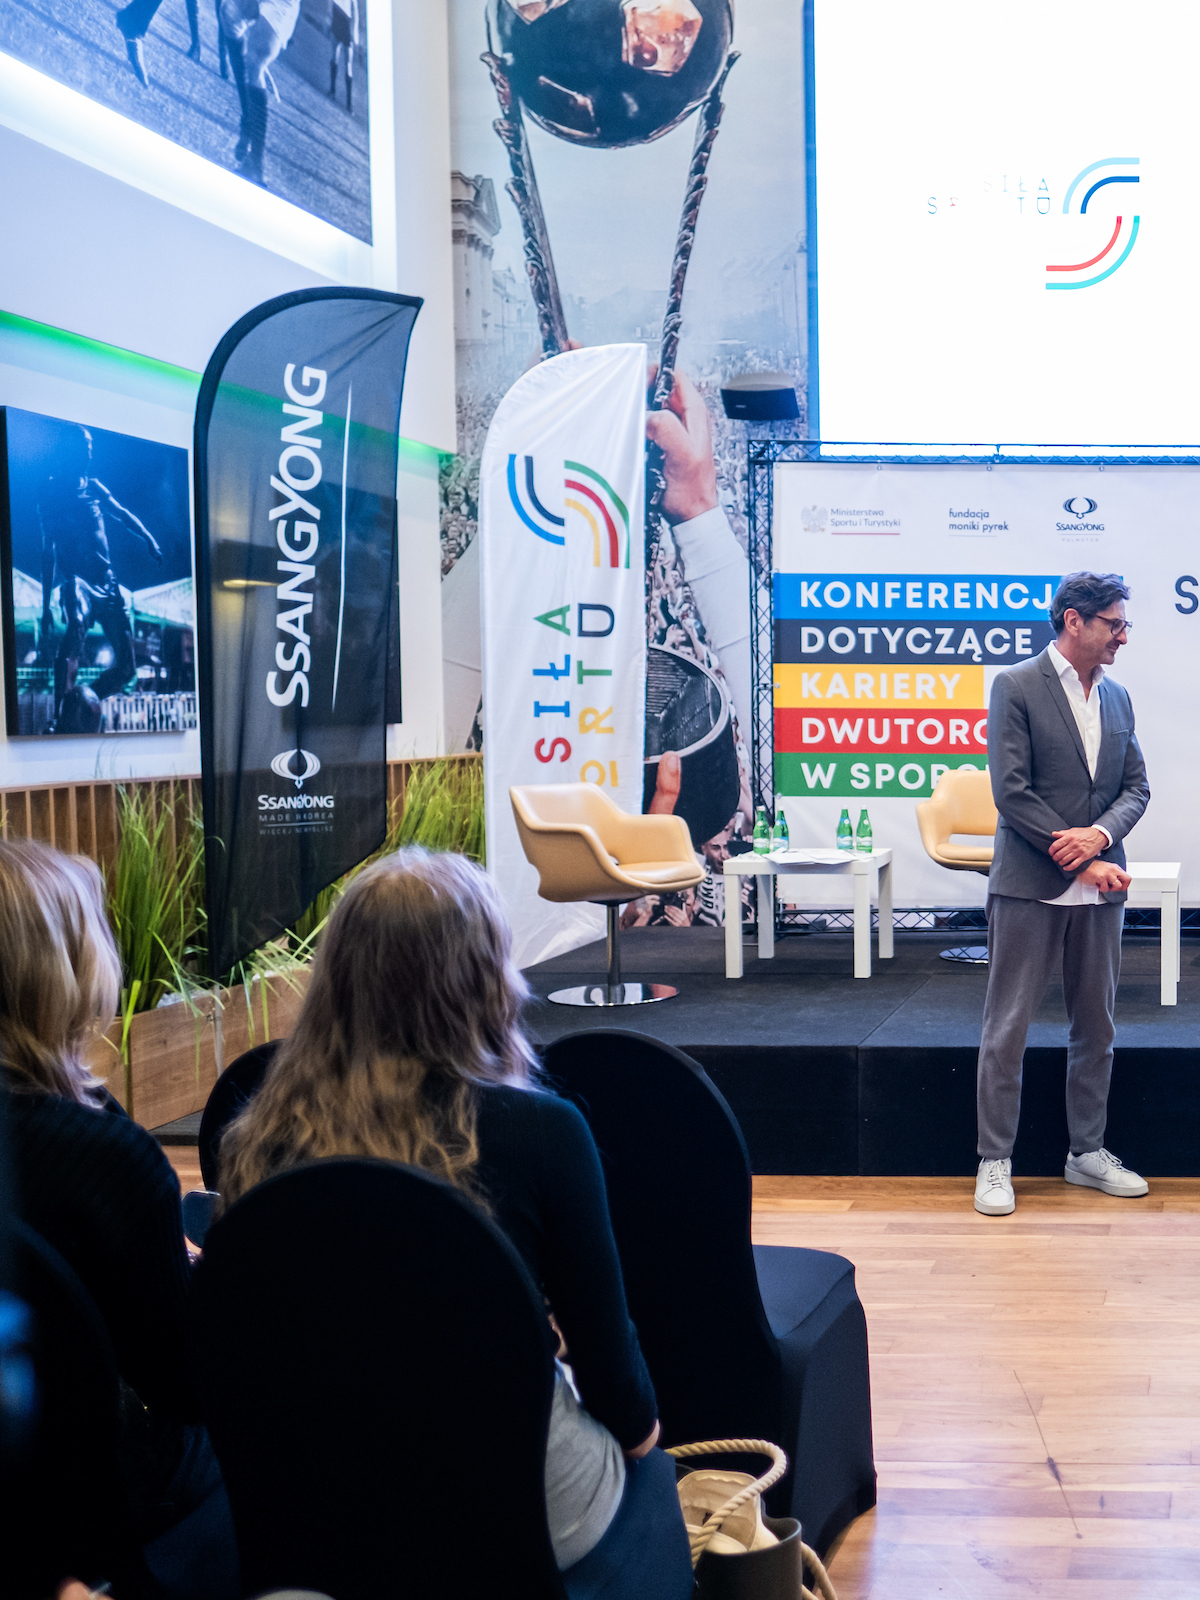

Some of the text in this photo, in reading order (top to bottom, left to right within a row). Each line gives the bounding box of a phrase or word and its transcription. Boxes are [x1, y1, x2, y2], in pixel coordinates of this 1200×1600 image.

[830, 508, 884, 516] Ministerstwo
[830, 518, 858, 527] Sportu
[863, 518, 901, 527] Turystyki
[948, 507, 990, 520] fundacja
[265, 362, 328, 708] SSANGYONG
[948, 520, 1009, 533] moniki pyrek
[1056, 522, 1105, 531] SSANGYONG
[800, 581, 1052, 610] KONFERENCJ
[800, 626, 1033, 662] DOTYCZĄCE
[532, 603, 572, 764] SIŁA
[576, 602, 619, 788] ORTU
[801, 672, 961, 700] KARIERY
[800, 762, 837, 789] W
